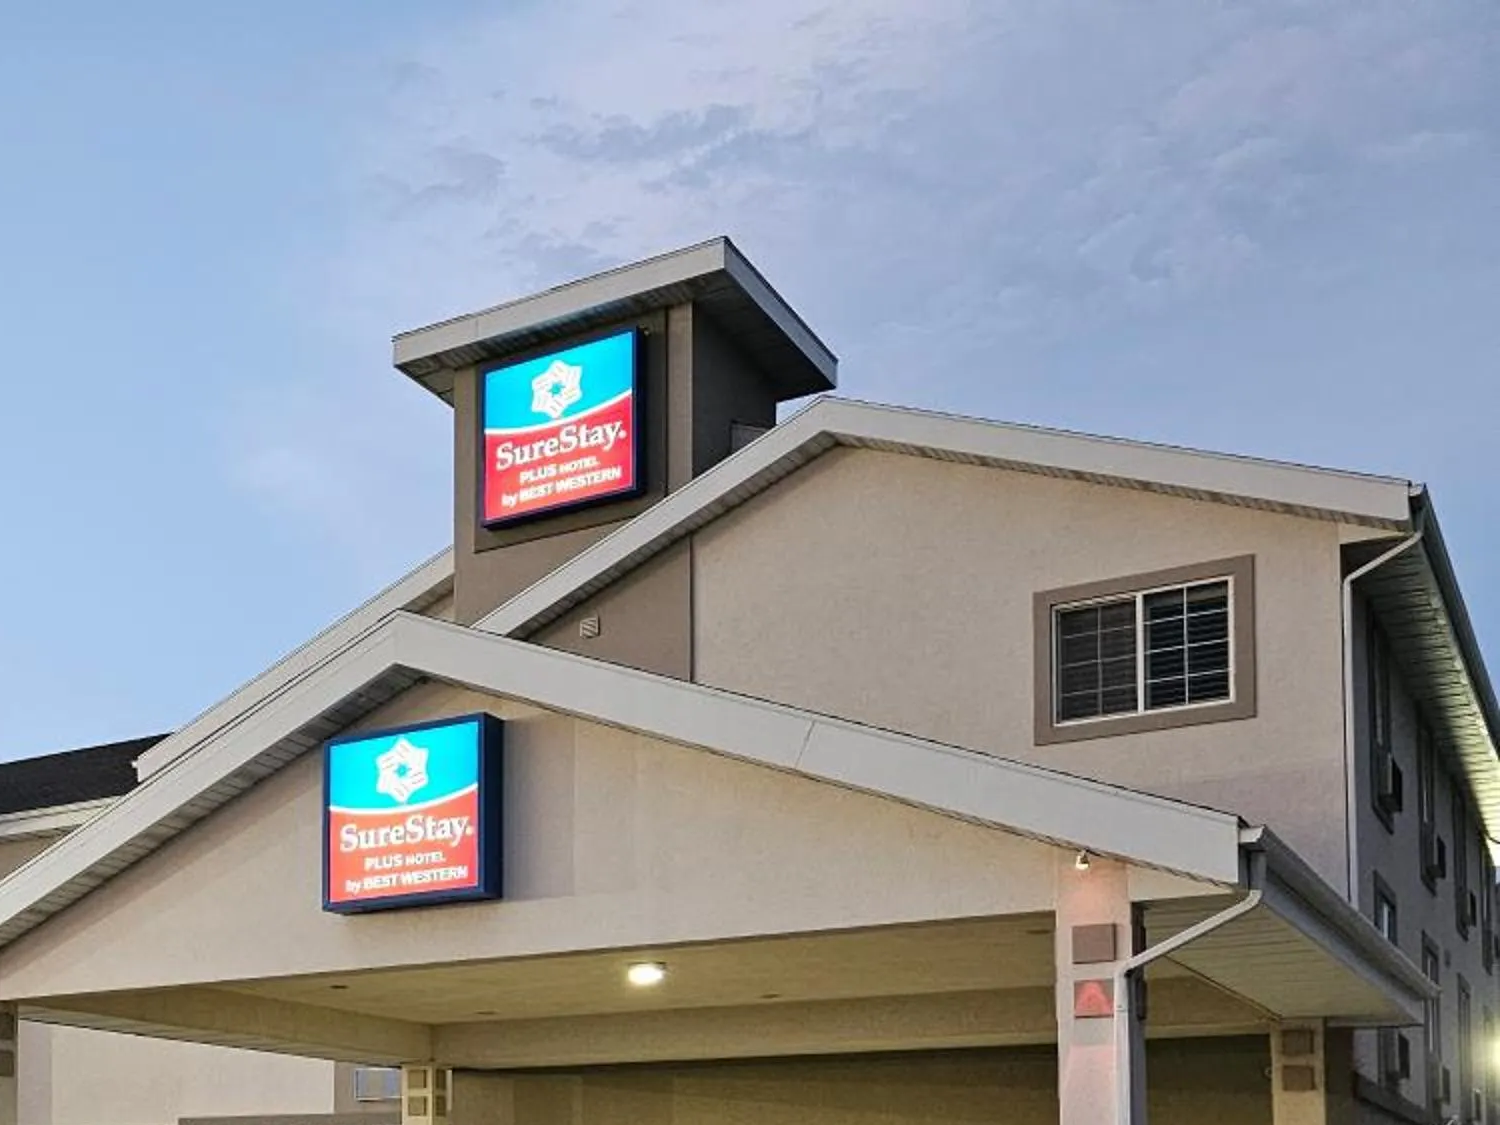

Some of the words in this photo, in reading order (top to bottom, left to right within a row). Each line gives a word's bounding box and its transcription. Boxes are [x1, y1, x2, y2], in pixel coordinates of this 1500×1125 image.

[501, 493, 518, 508] by
[519, 482, 555, 502] BEST
[555, 465, 622, 494] WESTERN
[519, 463, 558, 485] PLUS
[363, 853, 403, 872] PLUS
[405, 851, 446, 867] HOTEL
[345, 879, 362, 895] by
[362, 873, 400, 890] BEST
[400, 865, 469, 887] WESTERN
